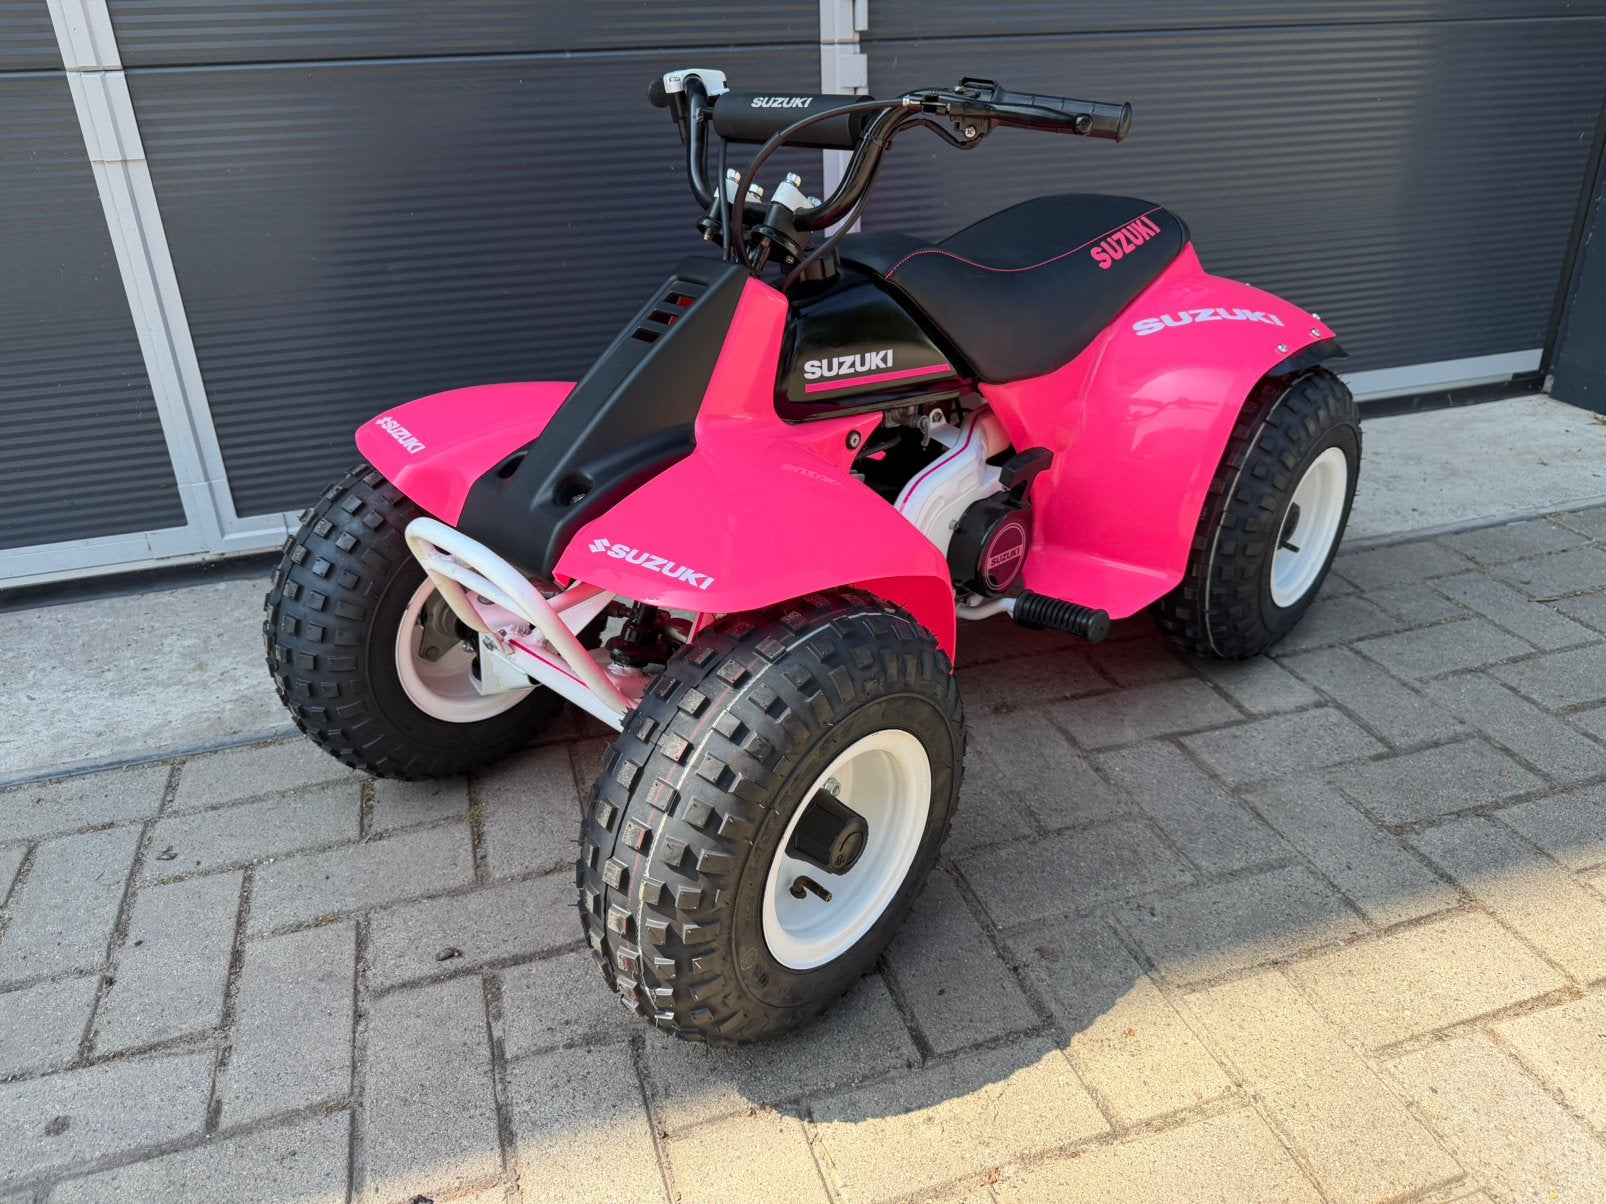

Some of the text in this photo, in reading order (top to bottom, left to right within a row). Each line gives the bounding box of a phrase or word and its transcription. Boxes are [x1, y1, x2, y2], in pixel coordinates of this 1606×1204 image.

[750, 96, 813, 109] SUZUKI
[1090, 215, 1162, 270] SUZUKI
[1132, 307, 1285, 336] SUZUKI
[803, 349, 894, 380] SUZUKI
[381, 418, 426, 455] SUZUKI
[606, 543, 715, 591] SUZUKI
[990, 546, 1021, 567] SUZUKI
